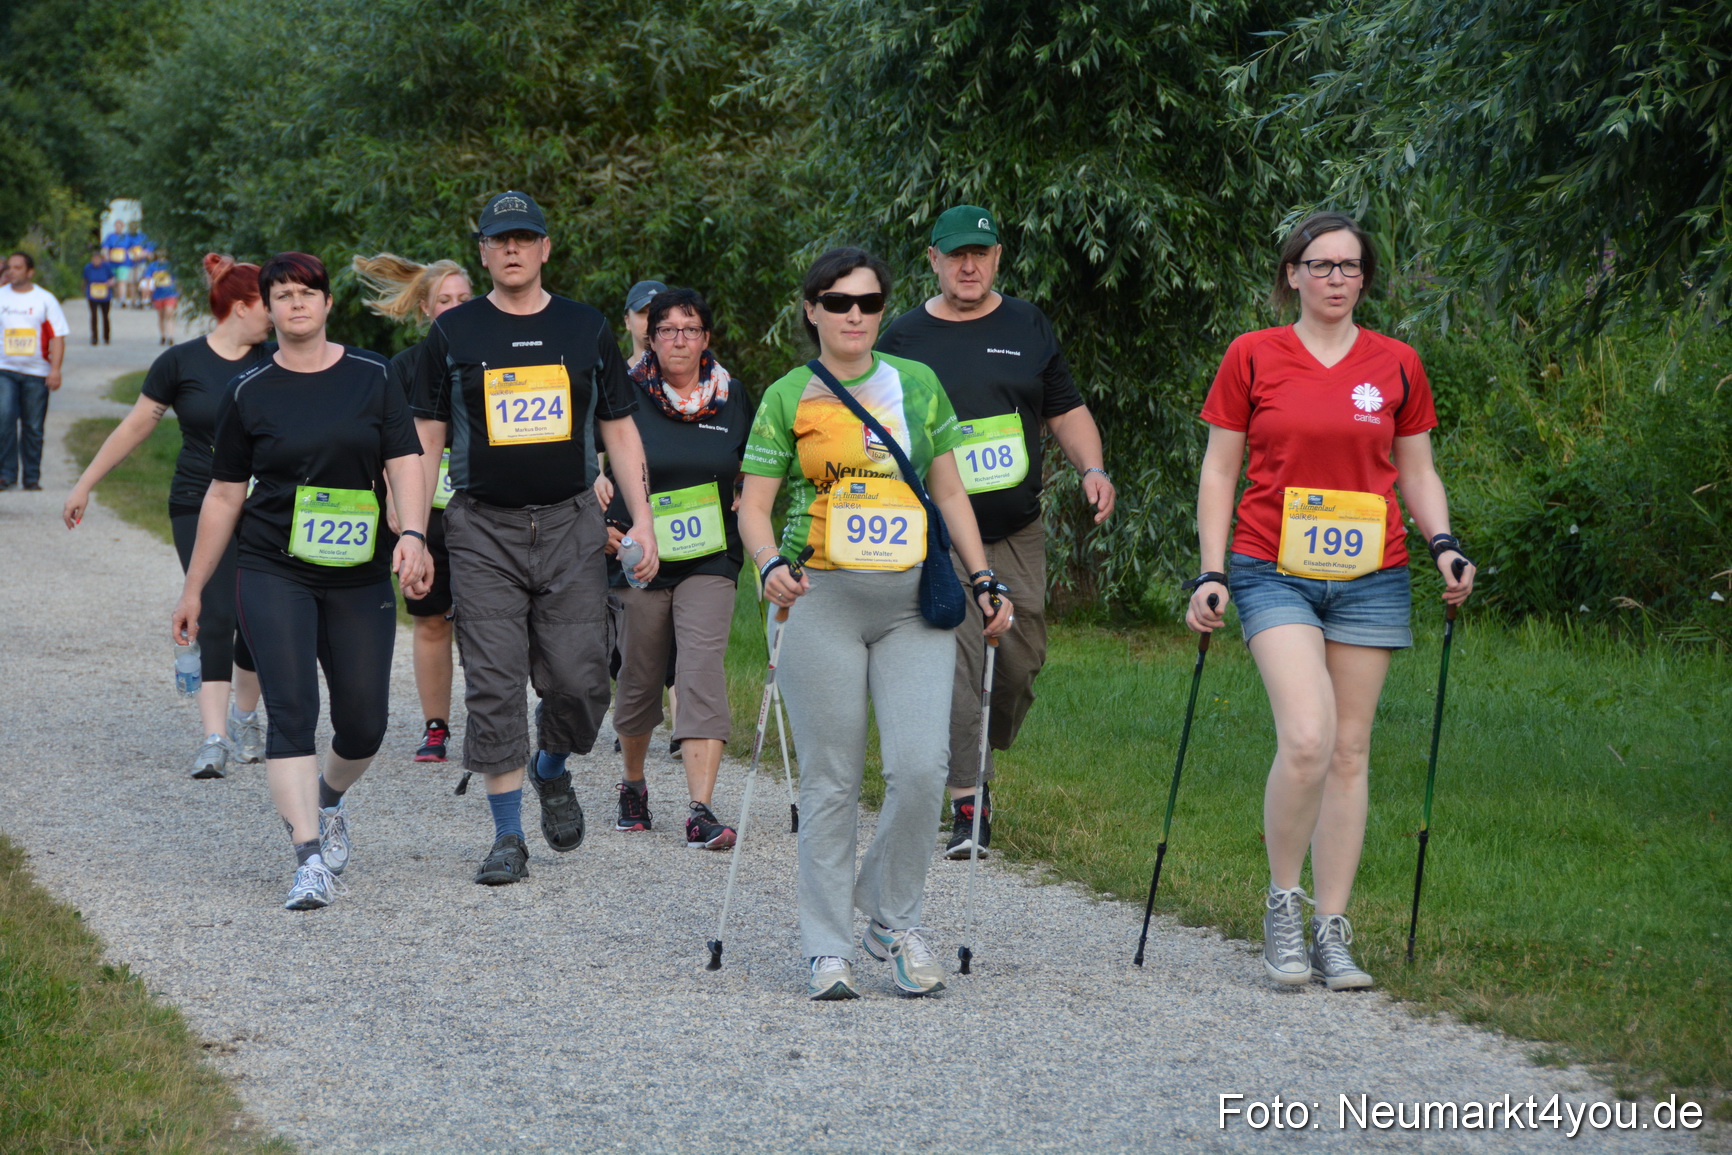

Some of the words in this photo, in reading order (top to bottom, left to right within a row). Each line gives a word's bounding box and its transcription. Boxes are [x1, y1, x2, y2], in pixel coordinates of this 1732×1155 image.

[495, 395, 563, 423] 1224
[1354, 413, 1381, 424] caritas
[754, 444, 778, 457] Genuss
[871, 451, 887, 460] 1628
[966, 445, 1013, 472] 108
[842, 492, 880, 501] firmenlauf
[1300, 503, 1337, 513] firmenlauf
[303, 519, 368, 546] 1223
[670, 516, 702, 541] 90
[846, 514, 908, 546] 992
[1303, 525, 1364, 558] 199
[1303, 559, 1332, 568] Elisabeth
[1332, 562, 1357, 570] Knaupp
